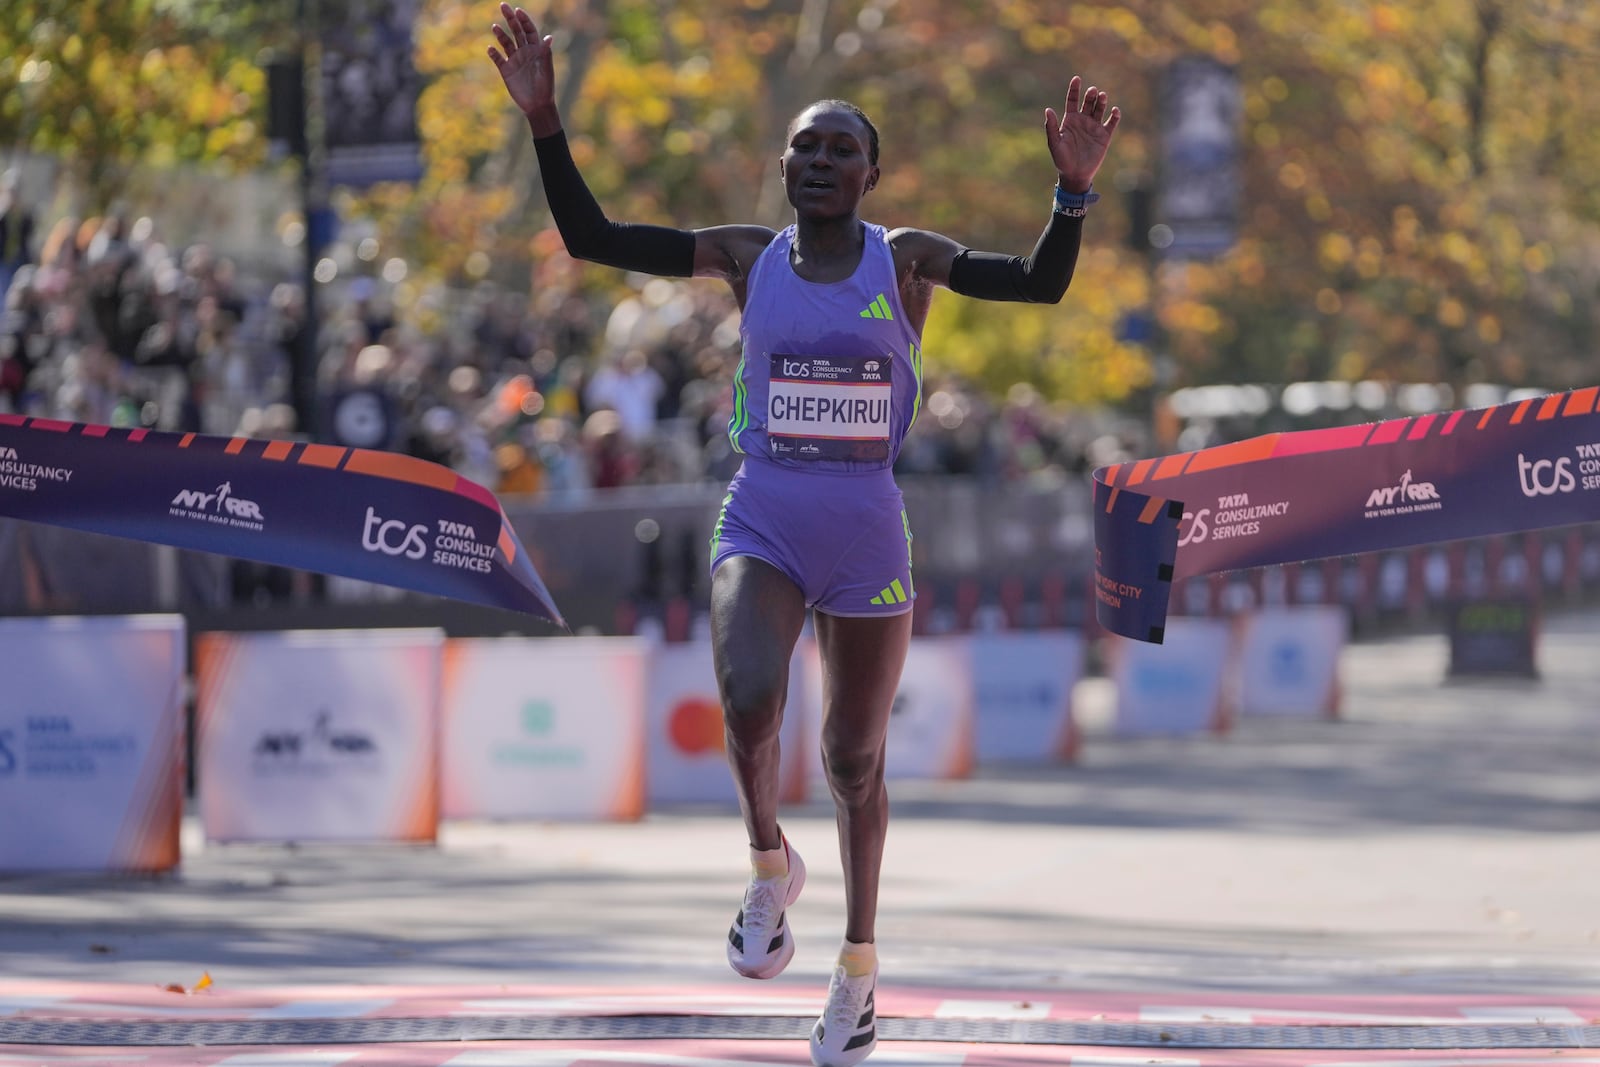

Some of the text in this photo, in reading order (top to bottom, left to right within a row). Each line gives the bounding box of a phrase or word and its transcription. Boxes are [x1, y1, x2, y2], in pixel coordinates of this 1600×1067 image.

[783, 358, 810, 378] tcs
[812, 366, 853, 374] CONSULTANCY
[862, 373, 881, 381] TATA
[771, 395, 888, 424] CHEPKIRUI
[0, 446, 18, 460] TA
[1575, 443, 1600, 459] TAT
[0, 460, 73, 482] NSULTANCY
[1518, 453, 1576, 497] tcs
[0, 473, 37, 490] VICES
[1218, 493, 1249, 509] TATA
[1379, 508, 1396, 517] YORK
[1396, 505, 1413, 514] ROAD
[1413, 502, 1442, 512] RUNNERS
[169, 507, 264, 531] NEW YORK ROAD RUNNERS
[1214, 501, 1290, 525] CONSULTANCY
[362, 506, 429, 560] tcs
[438, 519, 476, 539] TATA
[1211, 521, 1260, 540] SERVICES
[435, 535, 496, 559] CONSULT
[432, 550, 492, 574] SERVICES
[1118, 584, 1143, 600] CITY
